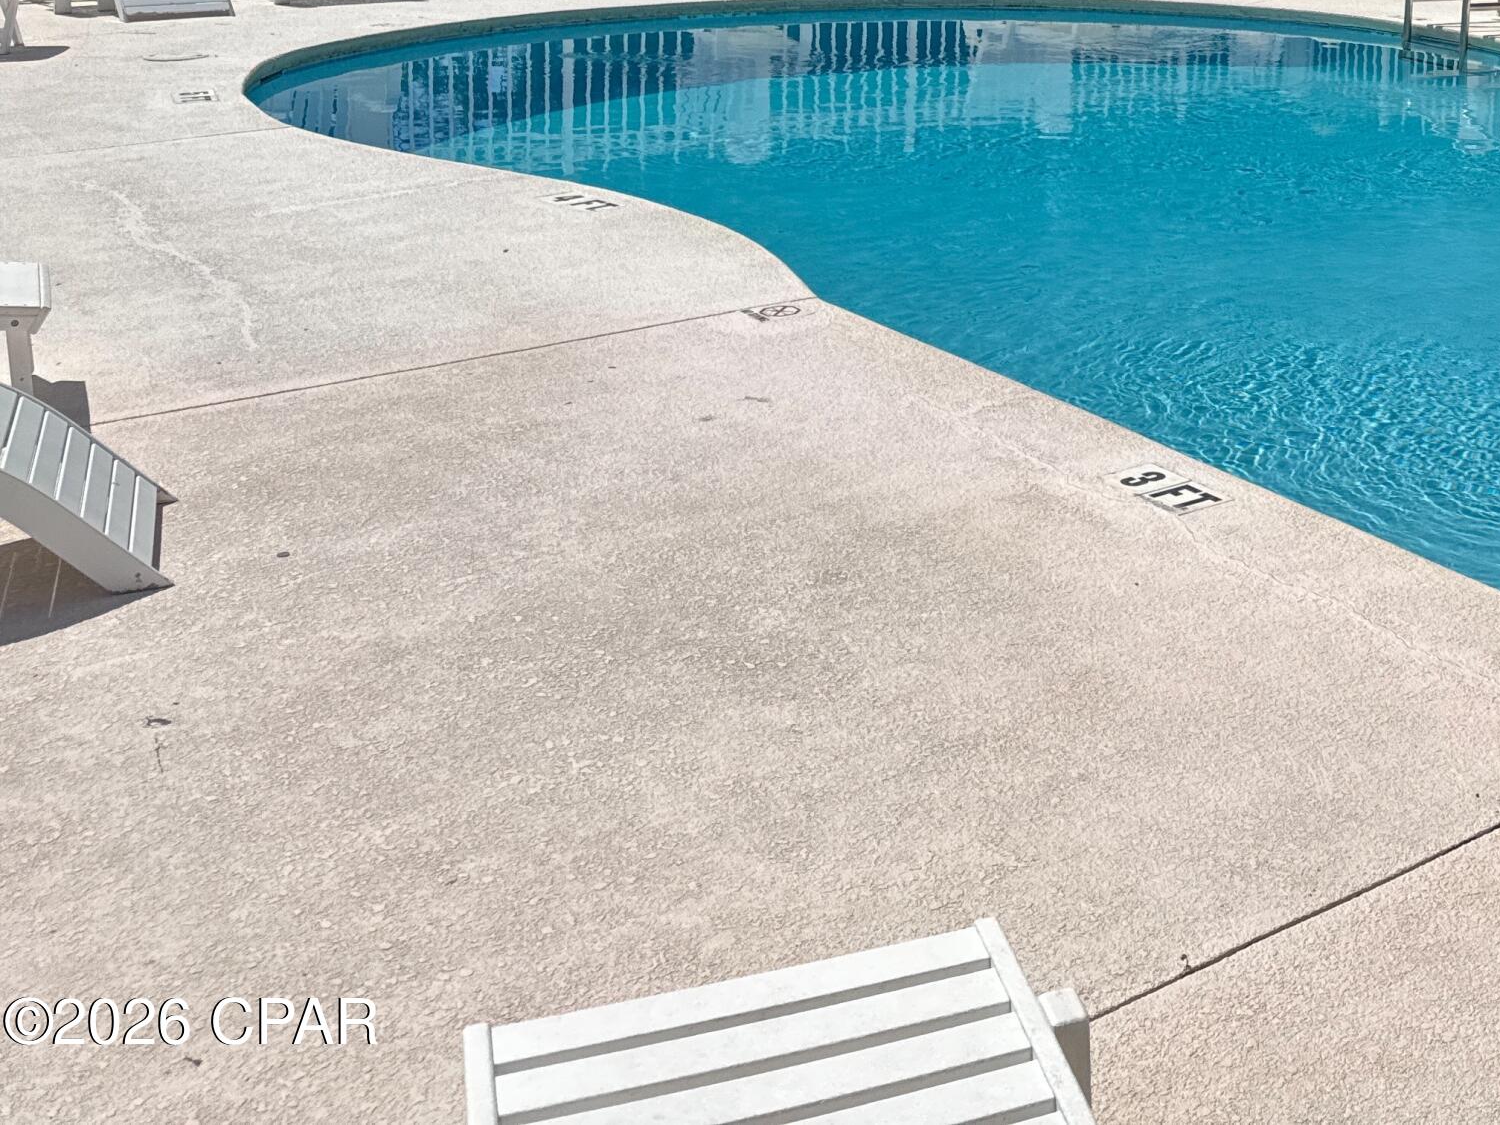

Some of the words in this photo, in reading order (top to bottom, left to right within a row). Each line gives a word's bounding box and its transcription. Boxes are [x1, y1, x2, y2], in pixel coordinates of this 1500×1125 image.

[570, 199, 619, 211] FT
[1120, 471, 1166, 487] 3
[1149, 484, 1223, 508] FT
